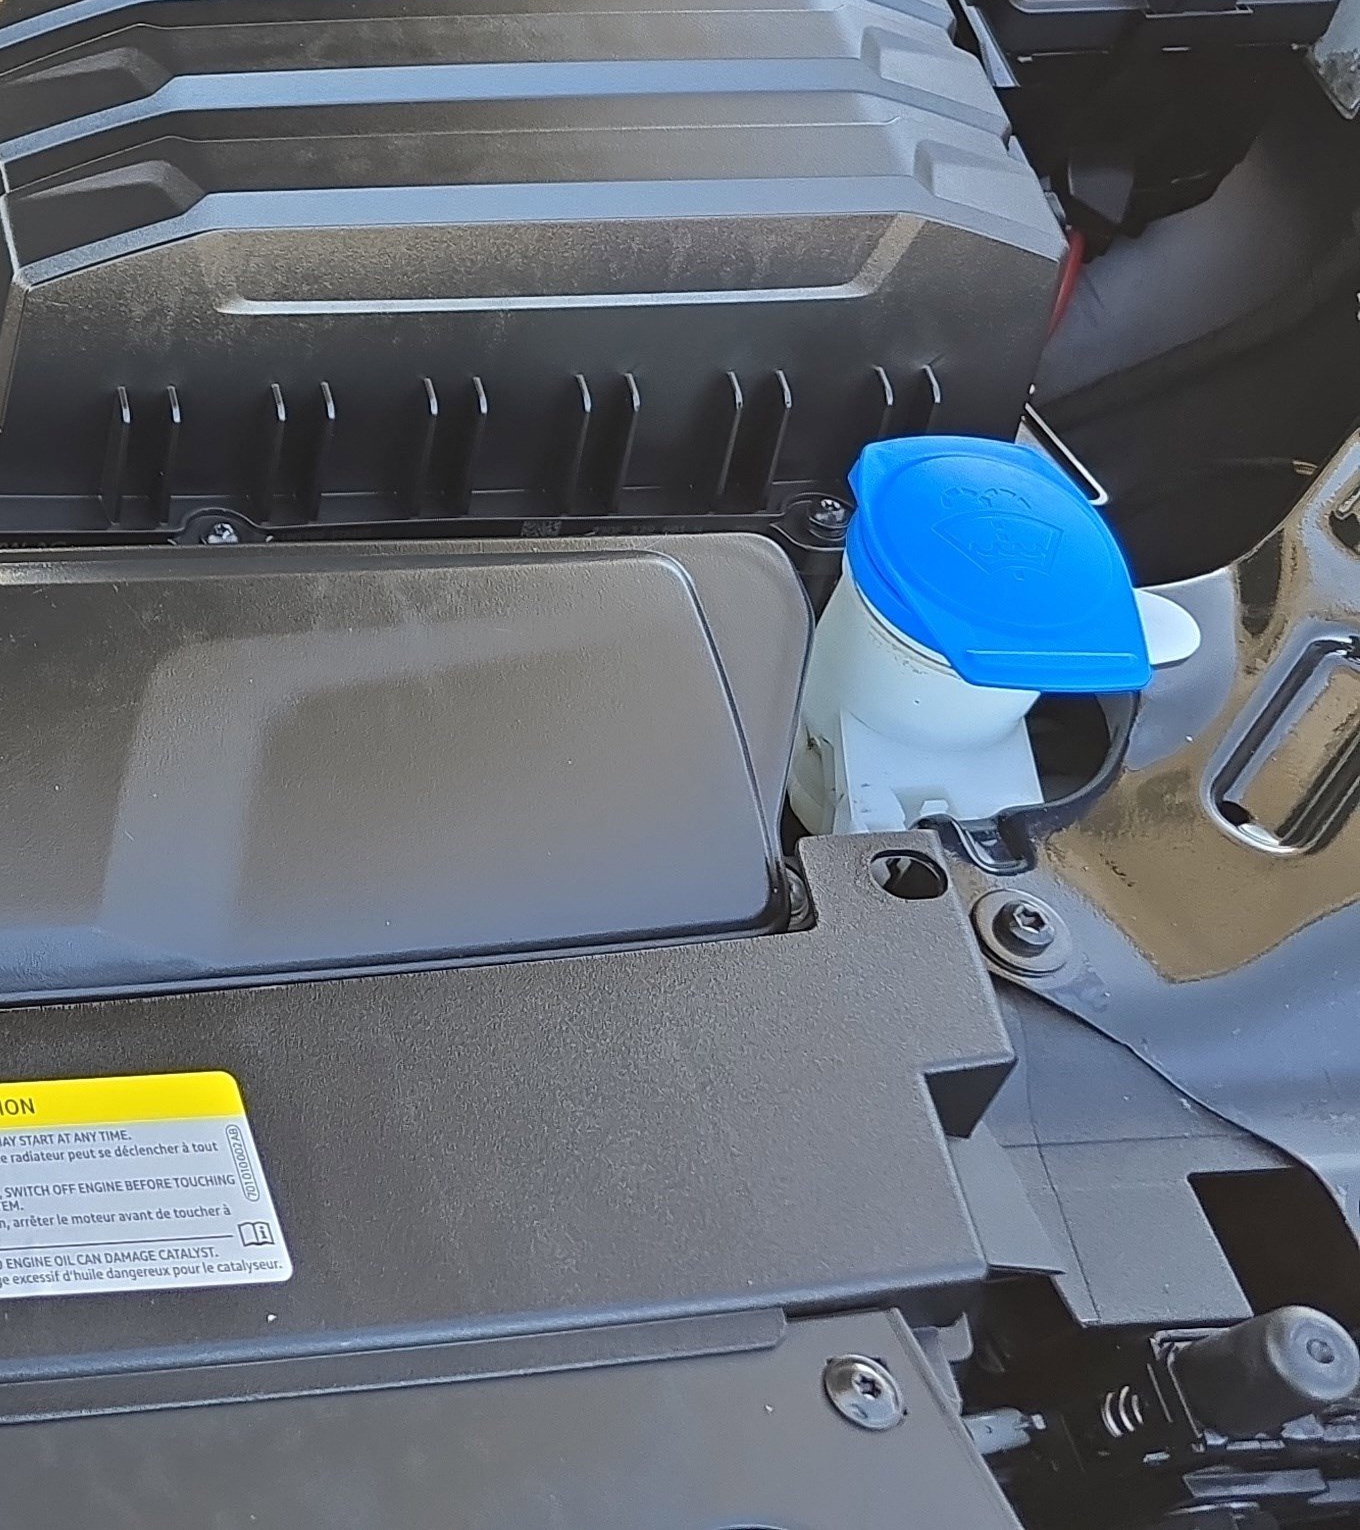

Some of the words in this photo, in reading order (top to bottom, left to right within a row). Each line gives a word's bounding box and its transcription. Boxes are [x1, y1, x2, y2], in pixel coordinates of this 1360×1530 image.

[20, 1134, 54, 1146] START
[57, 1133, 71, 1144] AT
[74, 1131, 96, 1143] ANY
[101, 1130, 132, 1141] TIME.
[10, 1150, 64, 1163] radiateur
[69, 1150, 94, 1162] peut
[98, 1150, 112, 1159] se
[115, 1143, 178, 1157] déclencher
[192, 1142, 218, 1152] tout
[5, 1185, 50, 1198] SWITCH
[53, 1184, 76, 1195] OFF
[77, 1180, 123, 1194] ENGINE
[125, 1178, 172, 1191] BEFORE
[174, 1174, 235, 1189] TOUCHING
[13, 1215, 55, 1228] arrêter
[57, 1214, 68, 1225] le
[71, 1211, 116, 1225] moteur
[119, 1209, 153, 1221] avant
[155, 1208, 171, 1220] de
[173, 1205, 221, 1218] toucher
[6, 1256, 51, 1269] ENGINE
[54, 1254, 75, 1266] OIL
[77, 1252, 102, 1265] CAN
[104, 1249, 156, 1263] DAMAGE
[159, 1246, 219, 1260] CATALYST.
[13, 1270, 60, 1285] excessif
[62, 1267, 104, 1282] d'huile
[106, 1266, 170, 1281] dangereux
[173, 1263, 200, 1277] pour
[203, 1261, 213, 1273] le
[217, 1259, 283, 1273] catalyseur.
